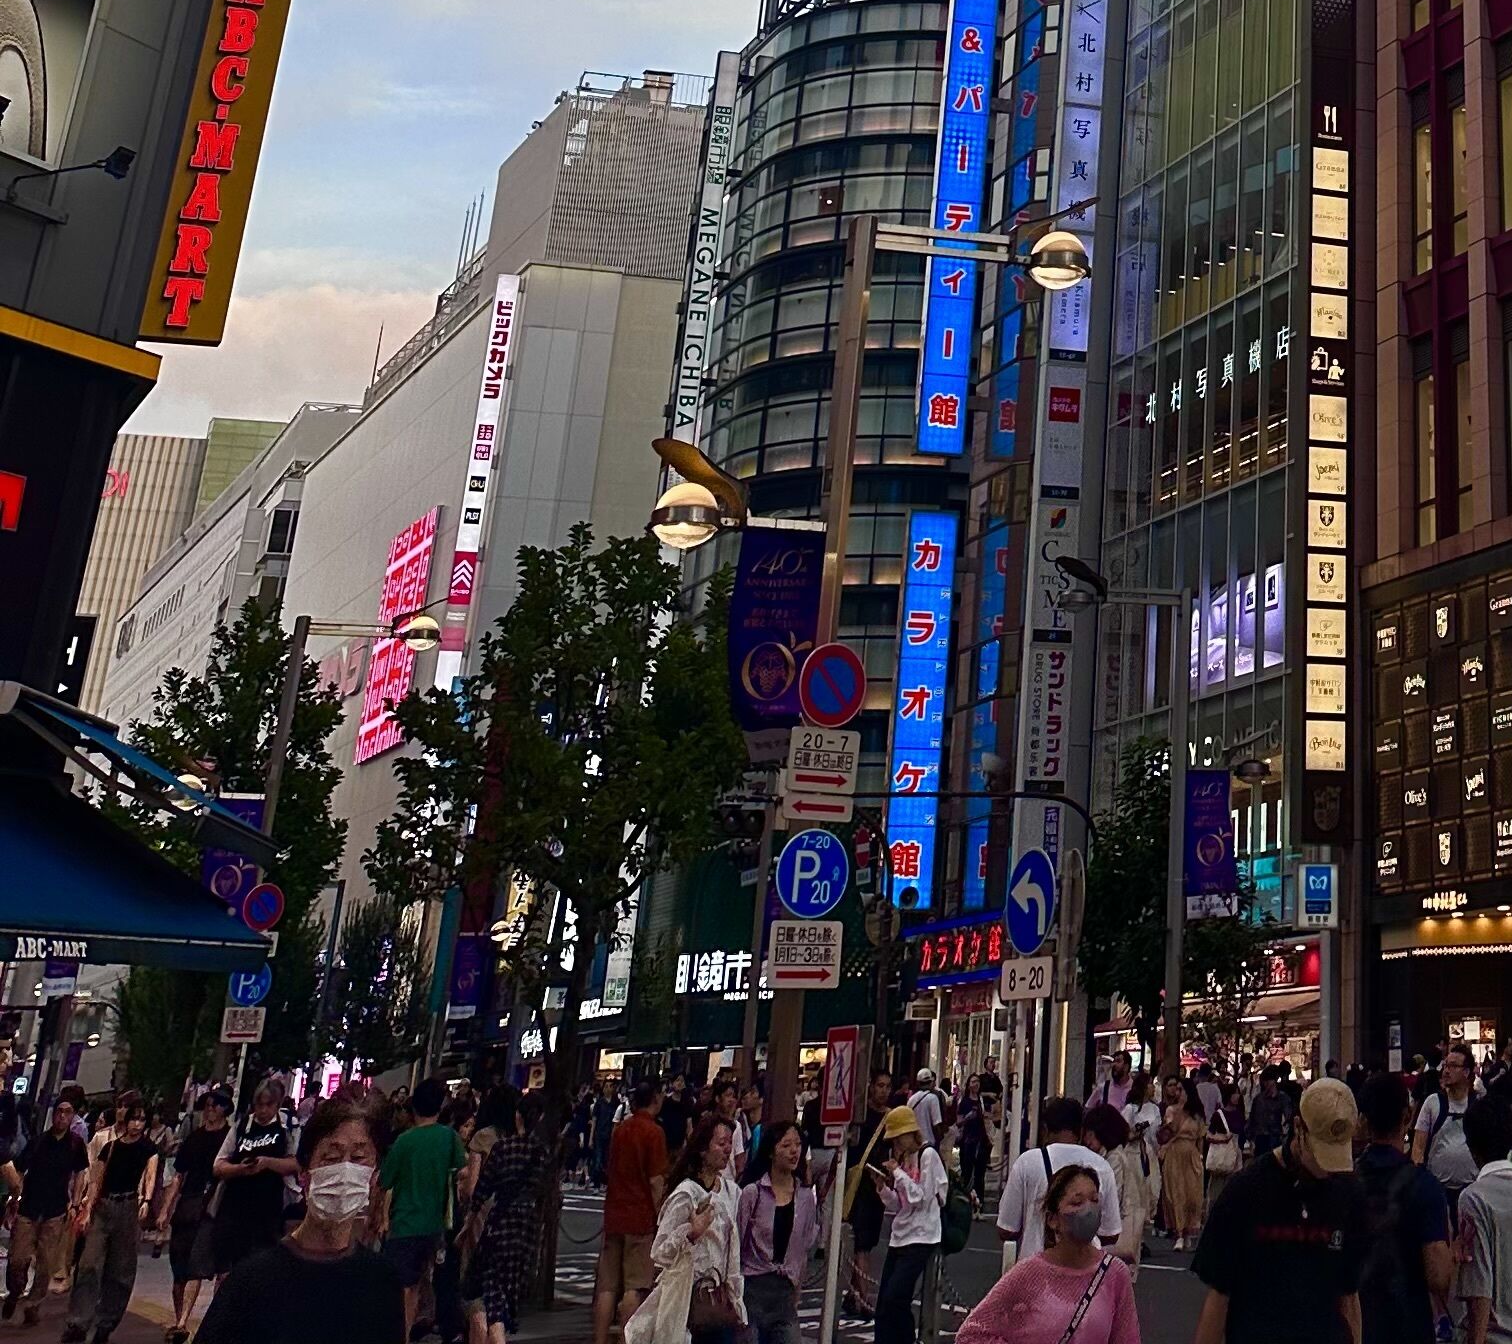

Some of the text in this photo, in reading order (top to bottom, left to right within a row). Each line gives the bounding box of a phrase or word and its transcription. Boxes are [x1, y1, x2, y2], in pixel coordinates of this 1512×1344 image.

[674, 207, 720, 428] MEGANE ICHIBA
[1043, 651, 1067, 778] サンドラッグ
[802, 836, 831, 849] 7-20
[791, 850, 821, 903] P
[811, 881, 831, 904] 20
[15, 936, 88, 959] ABC-MART
[674, 949, 767, 995] 眼鏡市
[1008, 966, 1045, 992] 8-20
